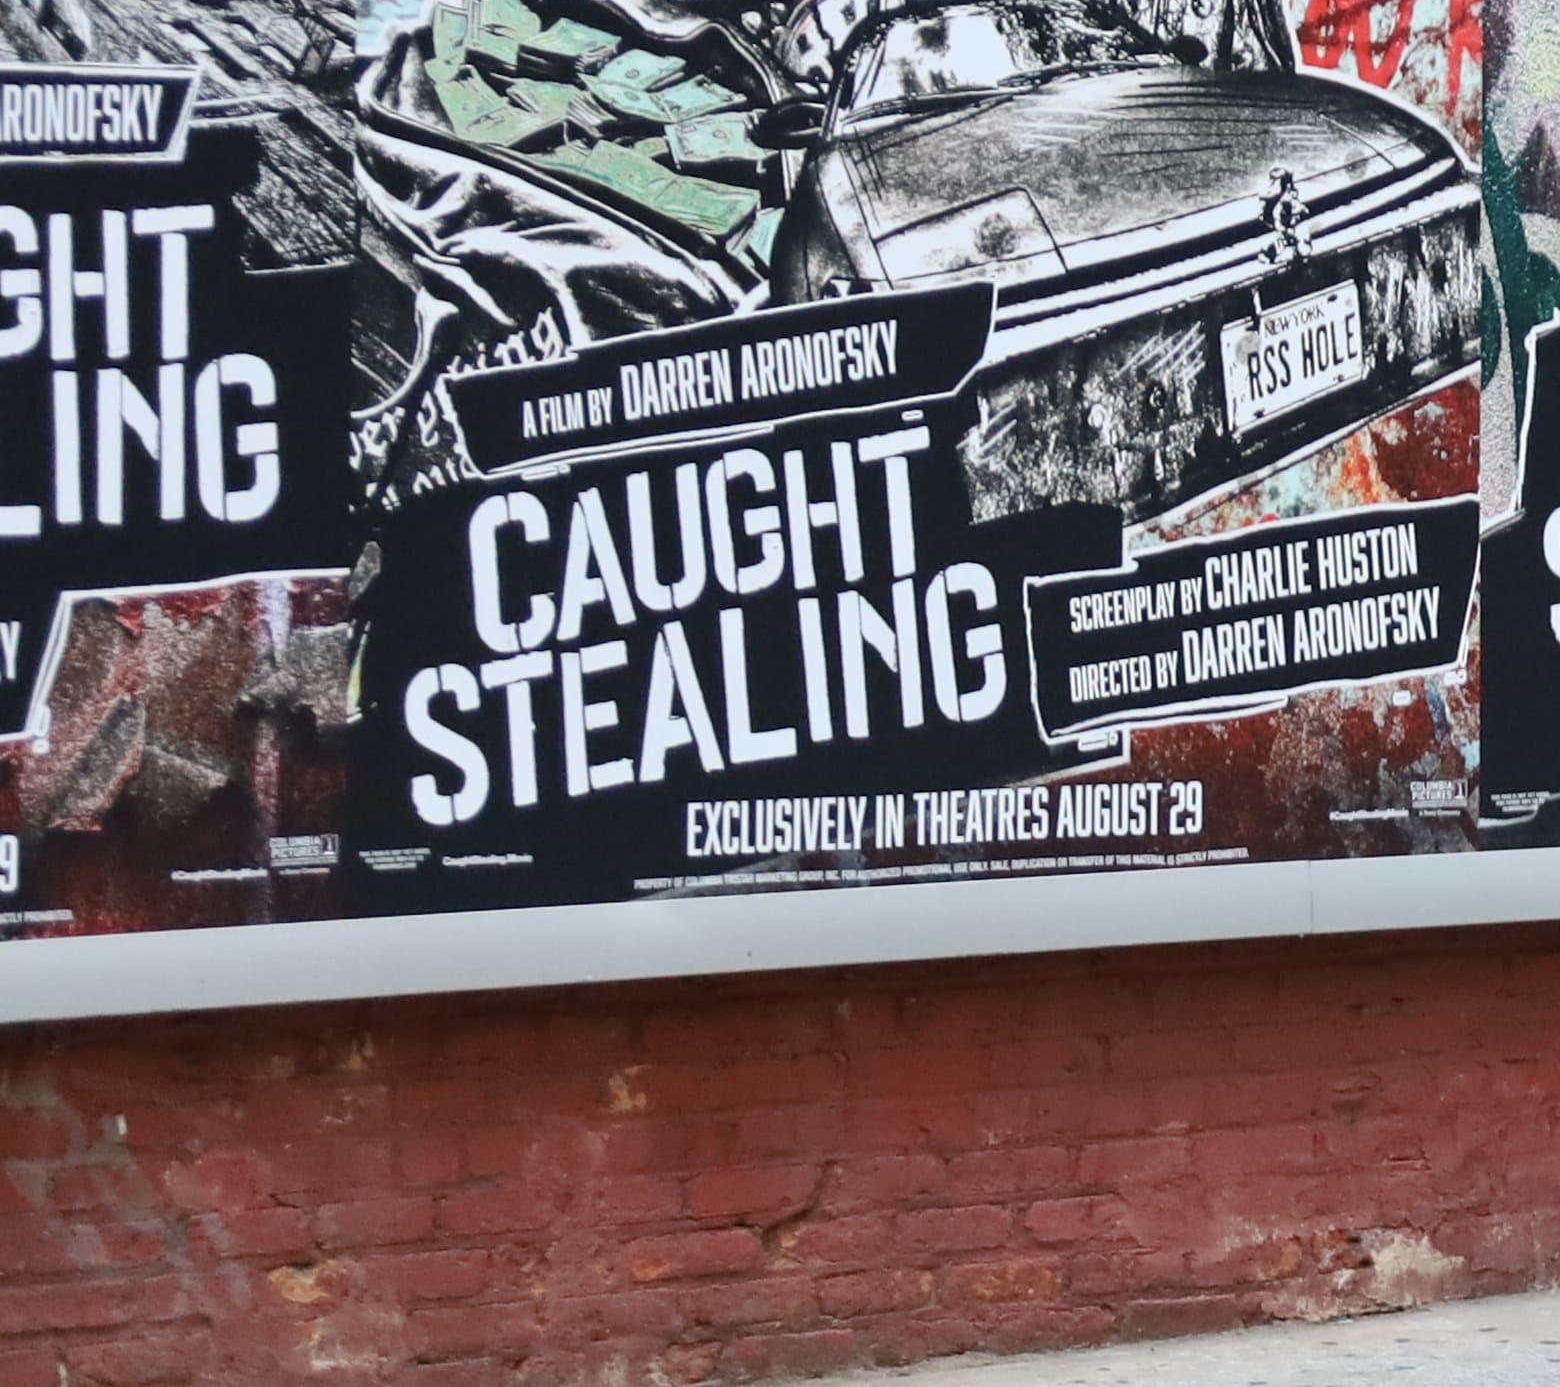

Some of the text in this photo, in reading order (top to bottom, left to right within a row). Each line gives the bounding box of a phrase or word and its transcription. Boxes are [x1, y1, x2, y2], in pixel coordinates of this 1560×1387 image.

[0, 83, 163, 144] RONOFSKY
[1247, 312, 1359, 402] RSS HOLE
[1264, 306, 1326, 338] NEW YORK
[522, 319, 899, 439] A FILM BY DARREN ARONOFSKY
[467, 426, 930, 652] CAUGHT
[1069, 523, 1418, 634] SCREENPLAY BY CHARLIE HUSTON
[404, 560, 1008, 826] STEALING
[1069, 586, 1441, 705] DIRECTED BY DARREN ARONOFSKY
[0, 833, 19, 893] 9
[686, 780, 1204, 858] EXCLUSIVELY IN THEATRES AUGUST 29
